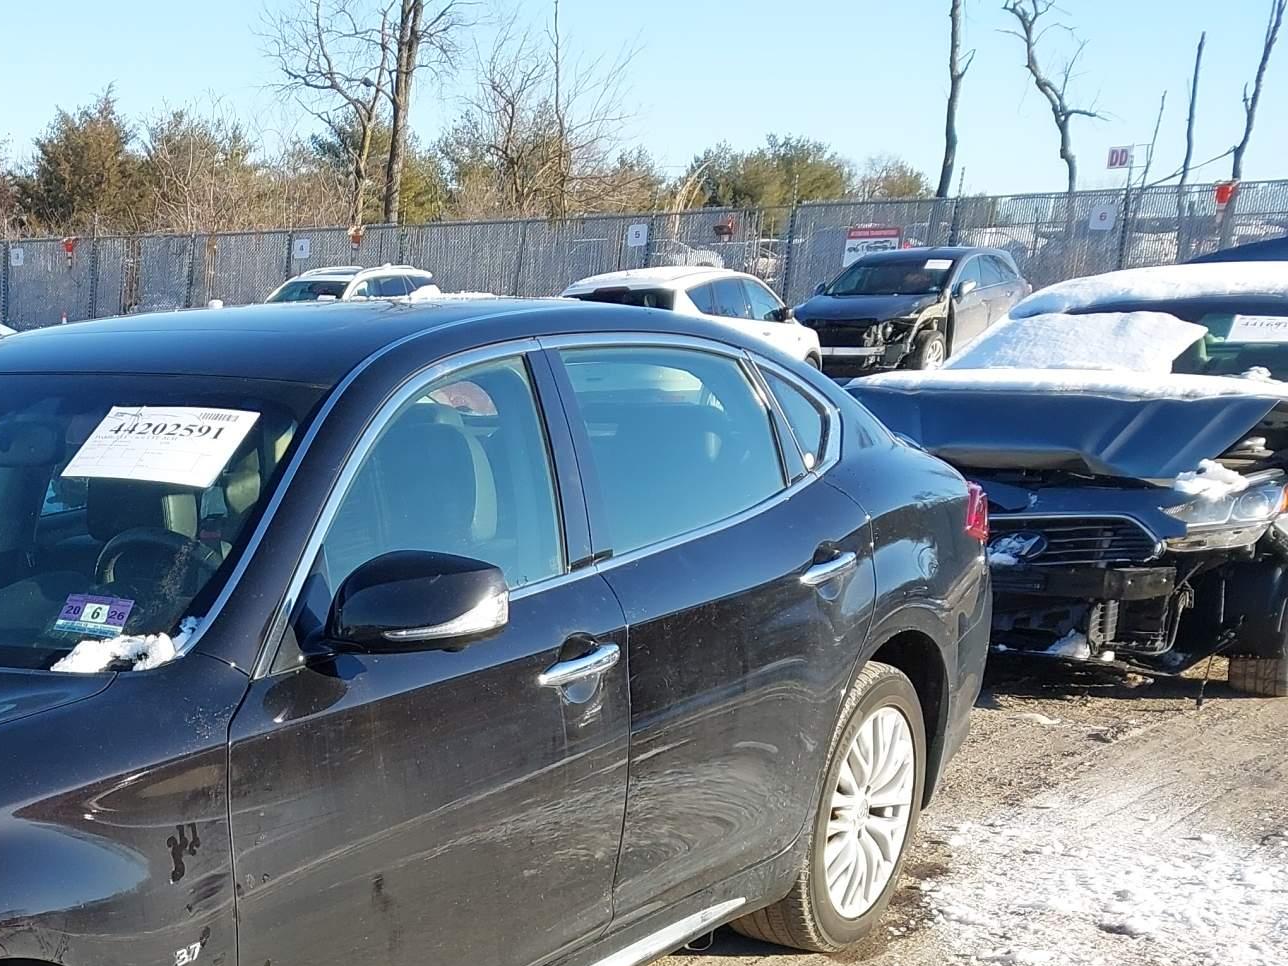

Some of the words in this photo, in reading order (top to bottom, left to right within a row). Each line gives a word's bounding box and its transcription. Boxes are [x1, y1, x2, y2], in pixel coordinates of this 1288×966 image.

[1109, 148, 1129, 167] DD
[1099, 211, 1108, 222] 6
[634, 230, 641, 239] 5
[109, 422, 225, 440] 44202591
[65, 605, 81, 615] 20
[91, 606, 102, 620] 6
[108, 610, 125, 621] 26
